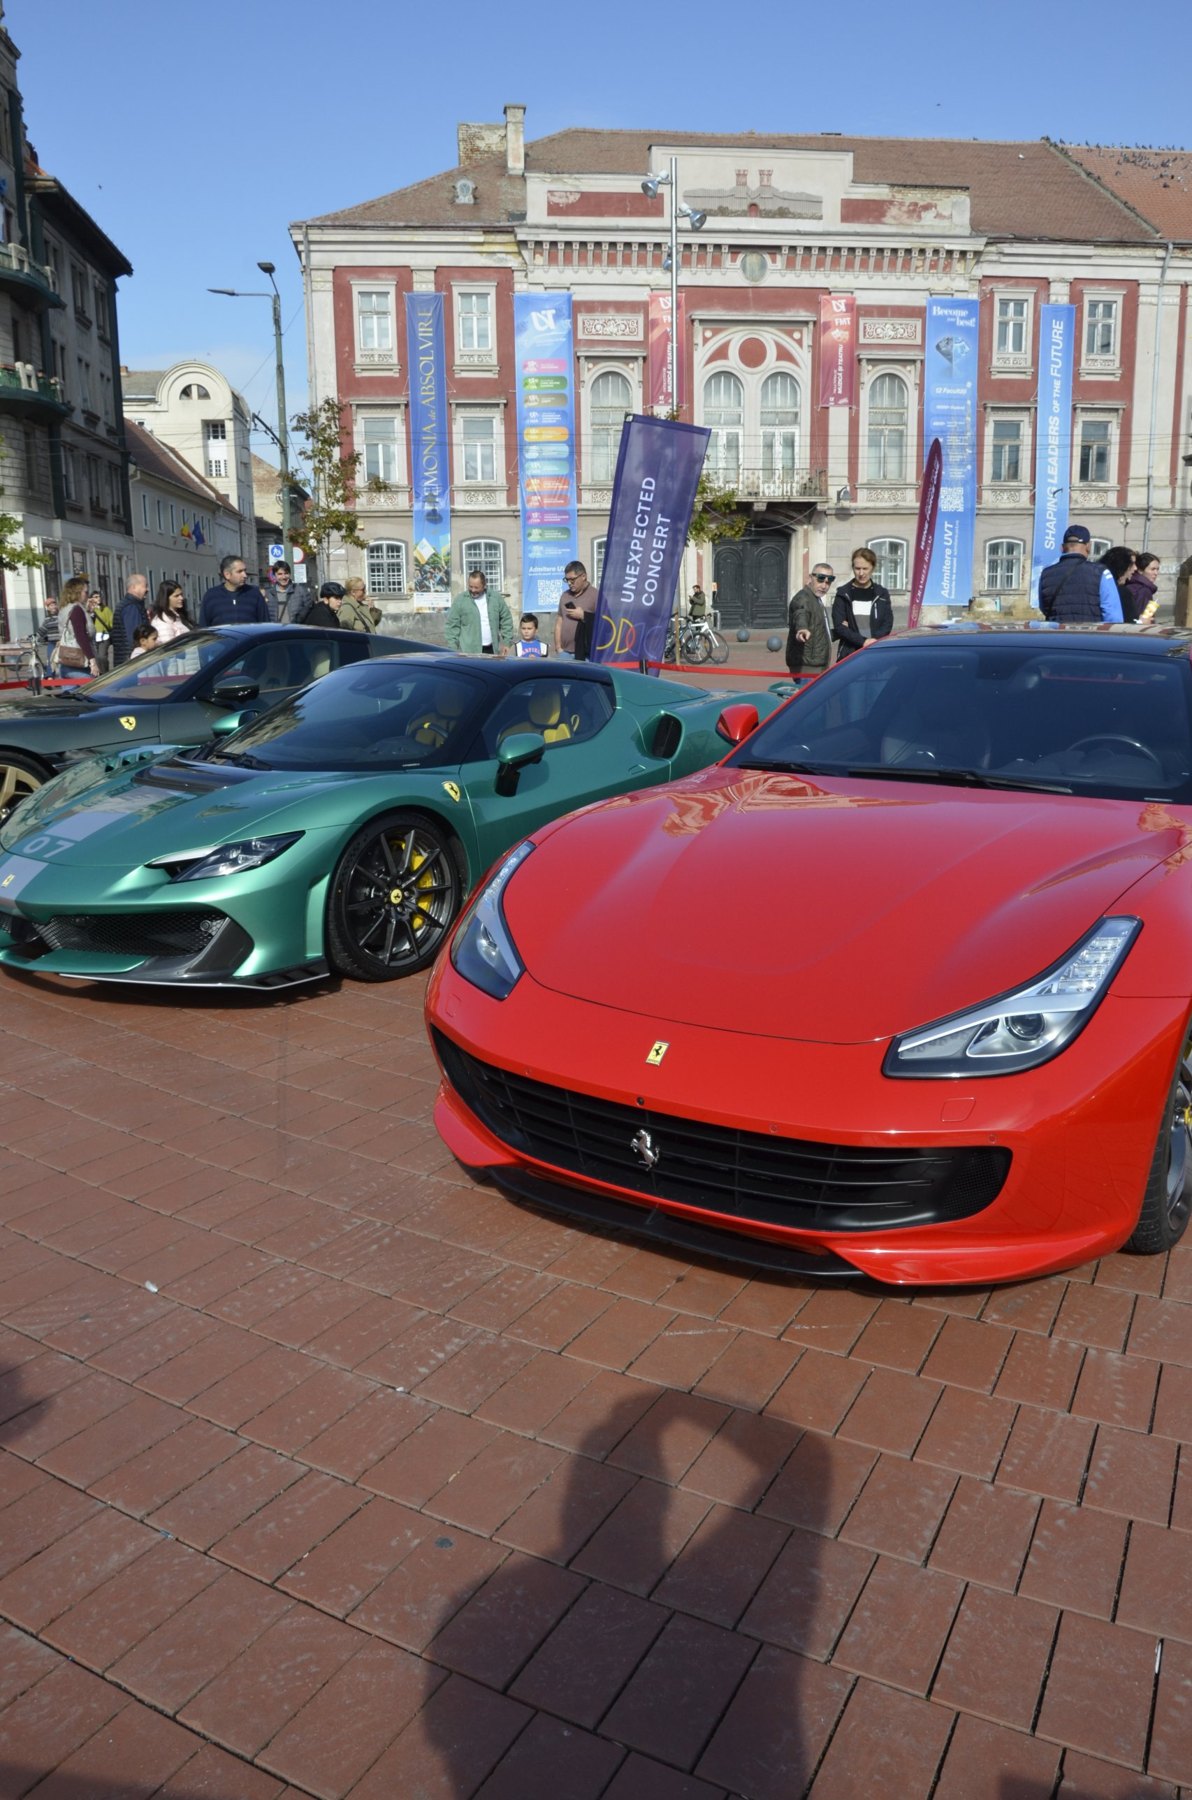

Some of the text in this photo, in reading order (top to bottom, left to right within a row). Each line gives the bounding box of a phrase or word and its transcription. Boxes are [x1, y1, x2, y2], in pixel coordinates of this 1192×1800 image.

[932, 306, 968, 317] Become
[417, 304, 436, 409] ABSOLVIRE
[428, 409, 436, 420] de
[1044, 319, 1064, 550] SHAPING LEADERS OF THE FUTURE
[620, 476, 656, 603] UNEXPECTED
[641, 513, 672, 607] CONCERT
[944, 520, 954, 546] UVT
[941, 546, 952, 599] Admitere
